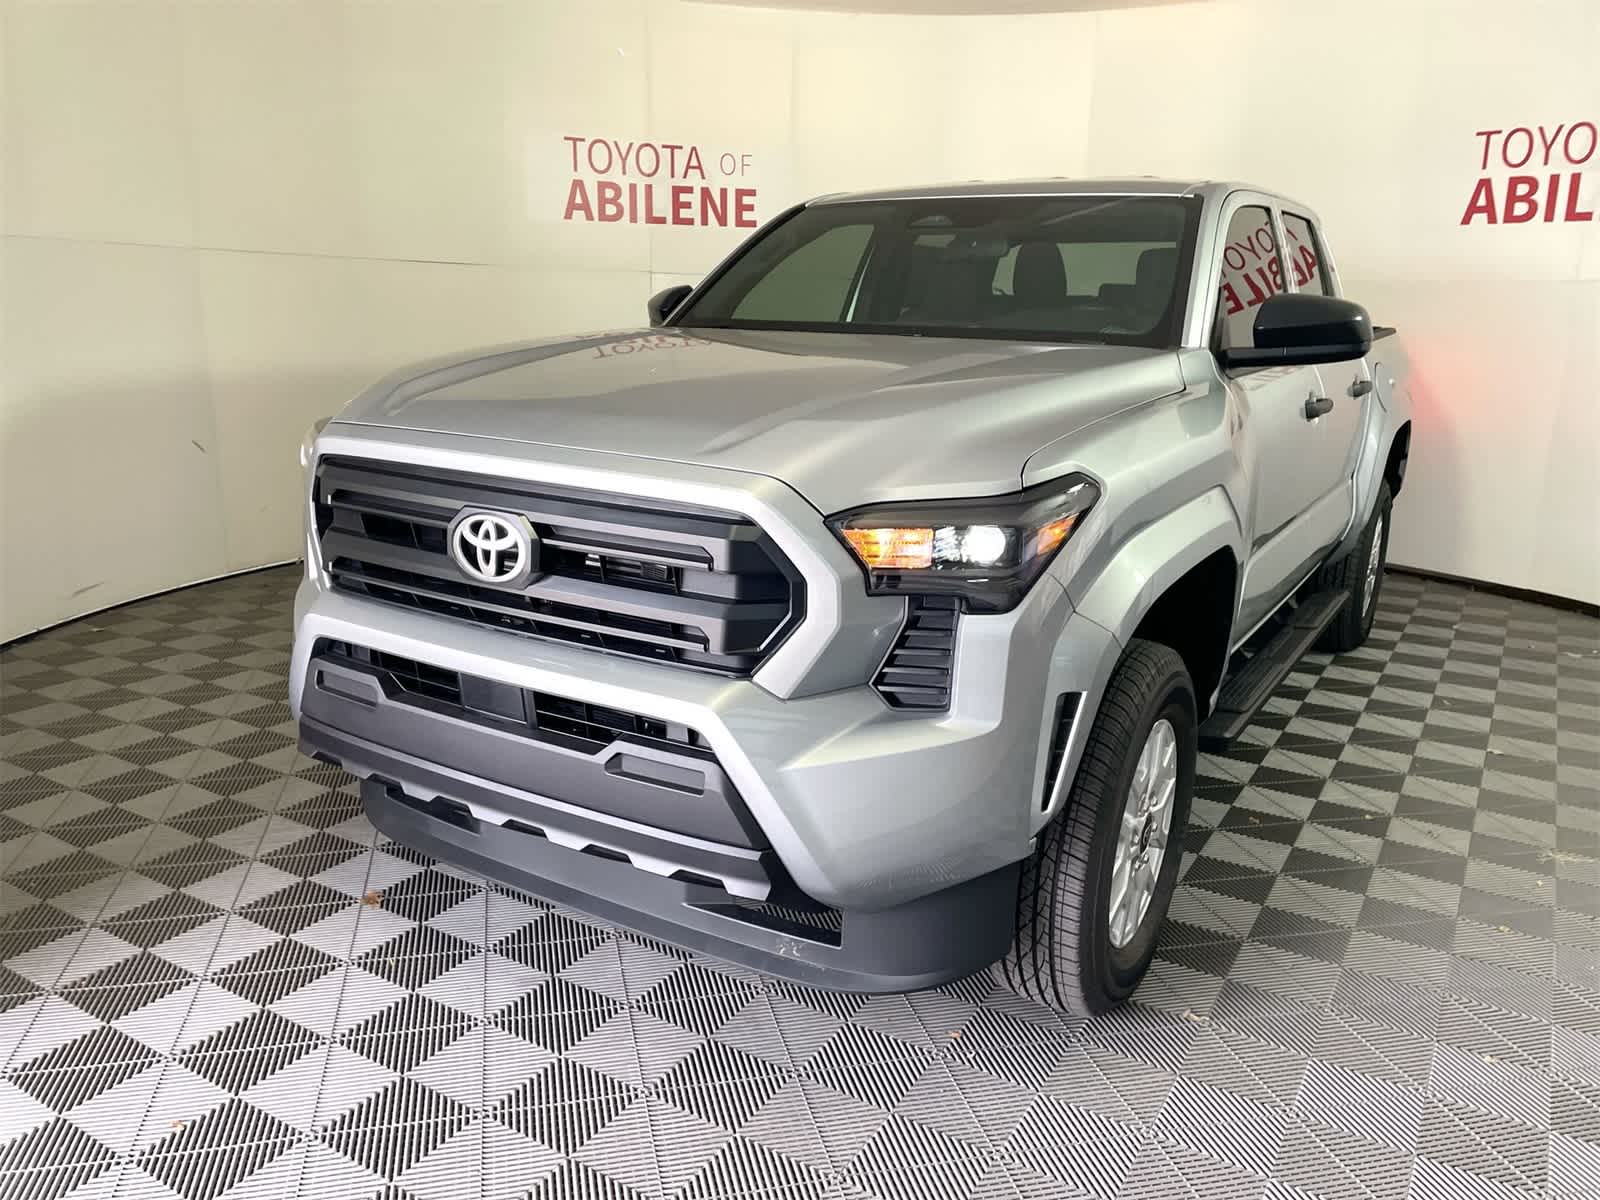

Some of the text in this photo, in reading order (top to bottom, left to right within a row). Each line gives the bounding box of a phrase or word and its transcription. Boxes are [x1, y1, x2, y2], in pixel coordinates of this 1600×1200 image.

[563, 135, 753, 180] TOYOTA OF
[1475, 121, 1598, 170] TOYO
[563, 178, 757, 228] ABILENE
[1460, 172, 1594, 225] ABIL
